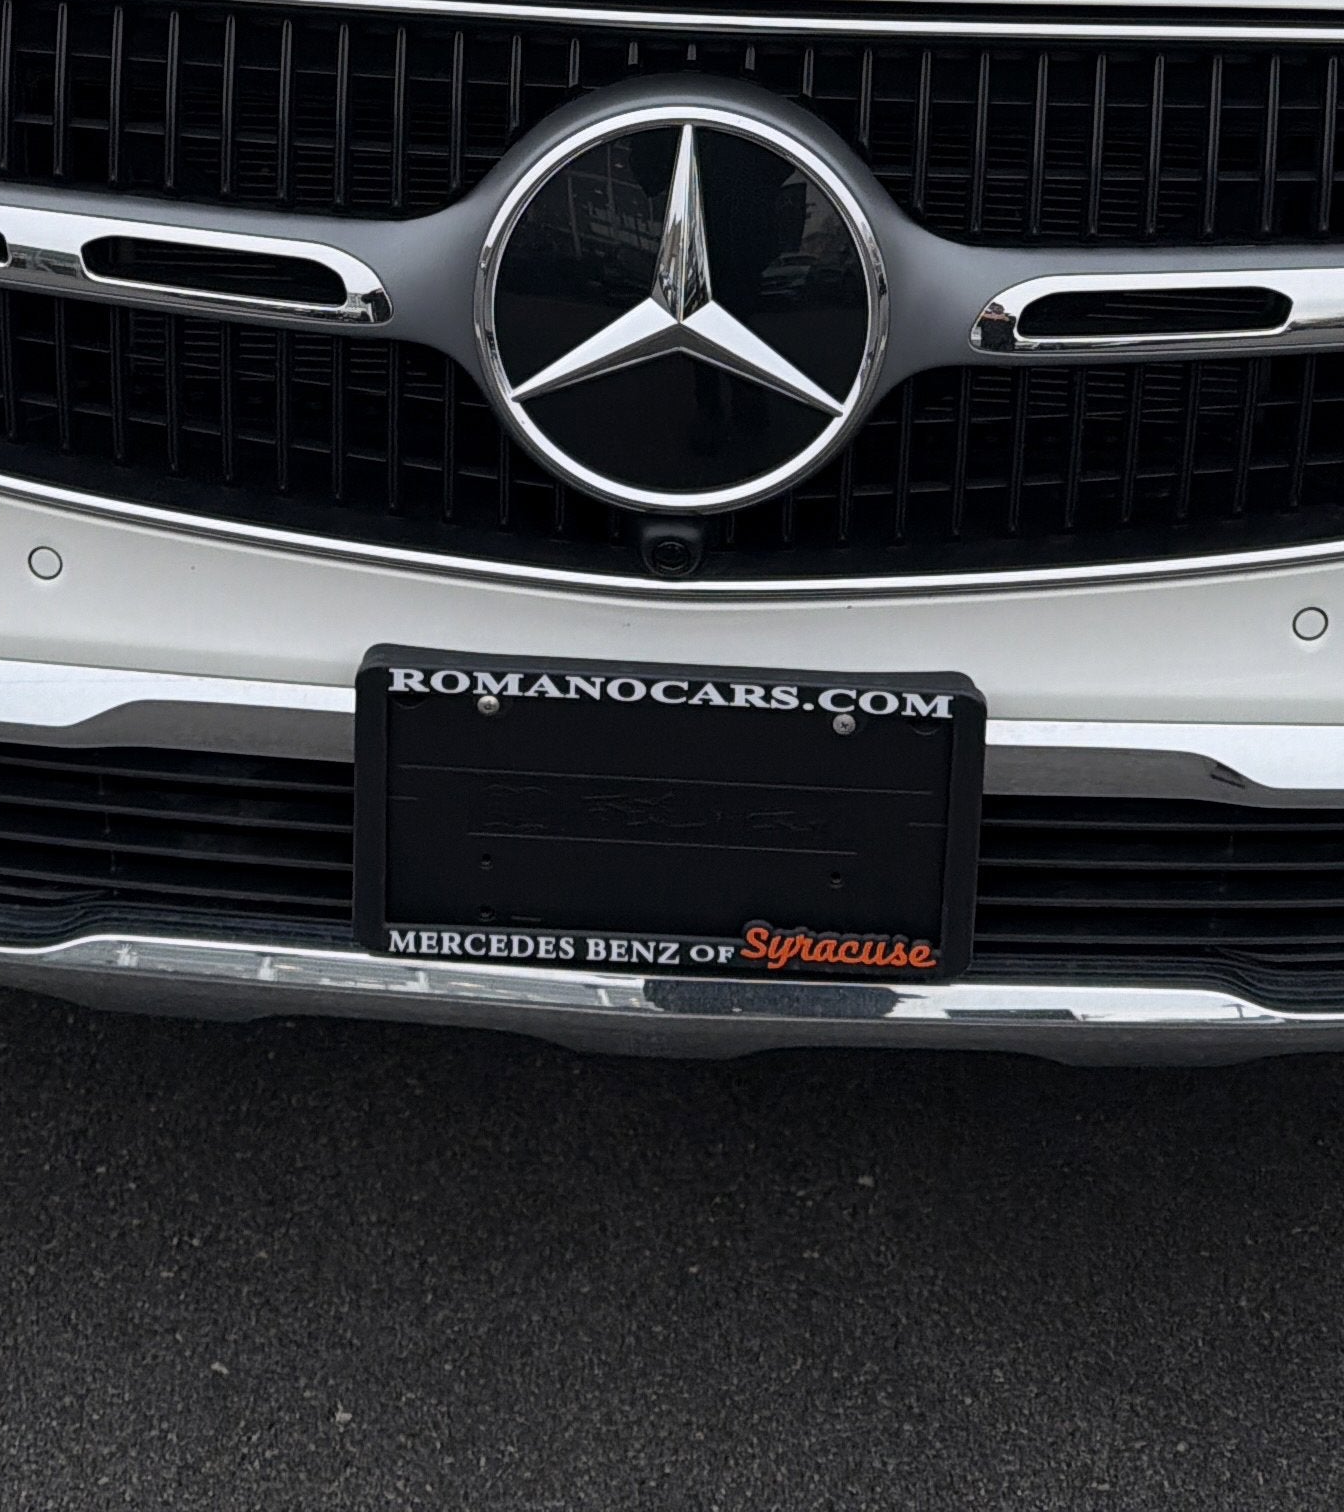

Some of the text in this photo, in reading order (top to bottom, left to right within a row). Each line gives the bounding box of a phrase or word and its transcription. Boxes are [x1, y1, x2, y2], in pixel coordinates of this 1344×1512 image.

[388, 668, 954, 719] ROMANOCARS.COM
[388, 928, 937, 970] MERCEDES BENZ OF Syracuse
